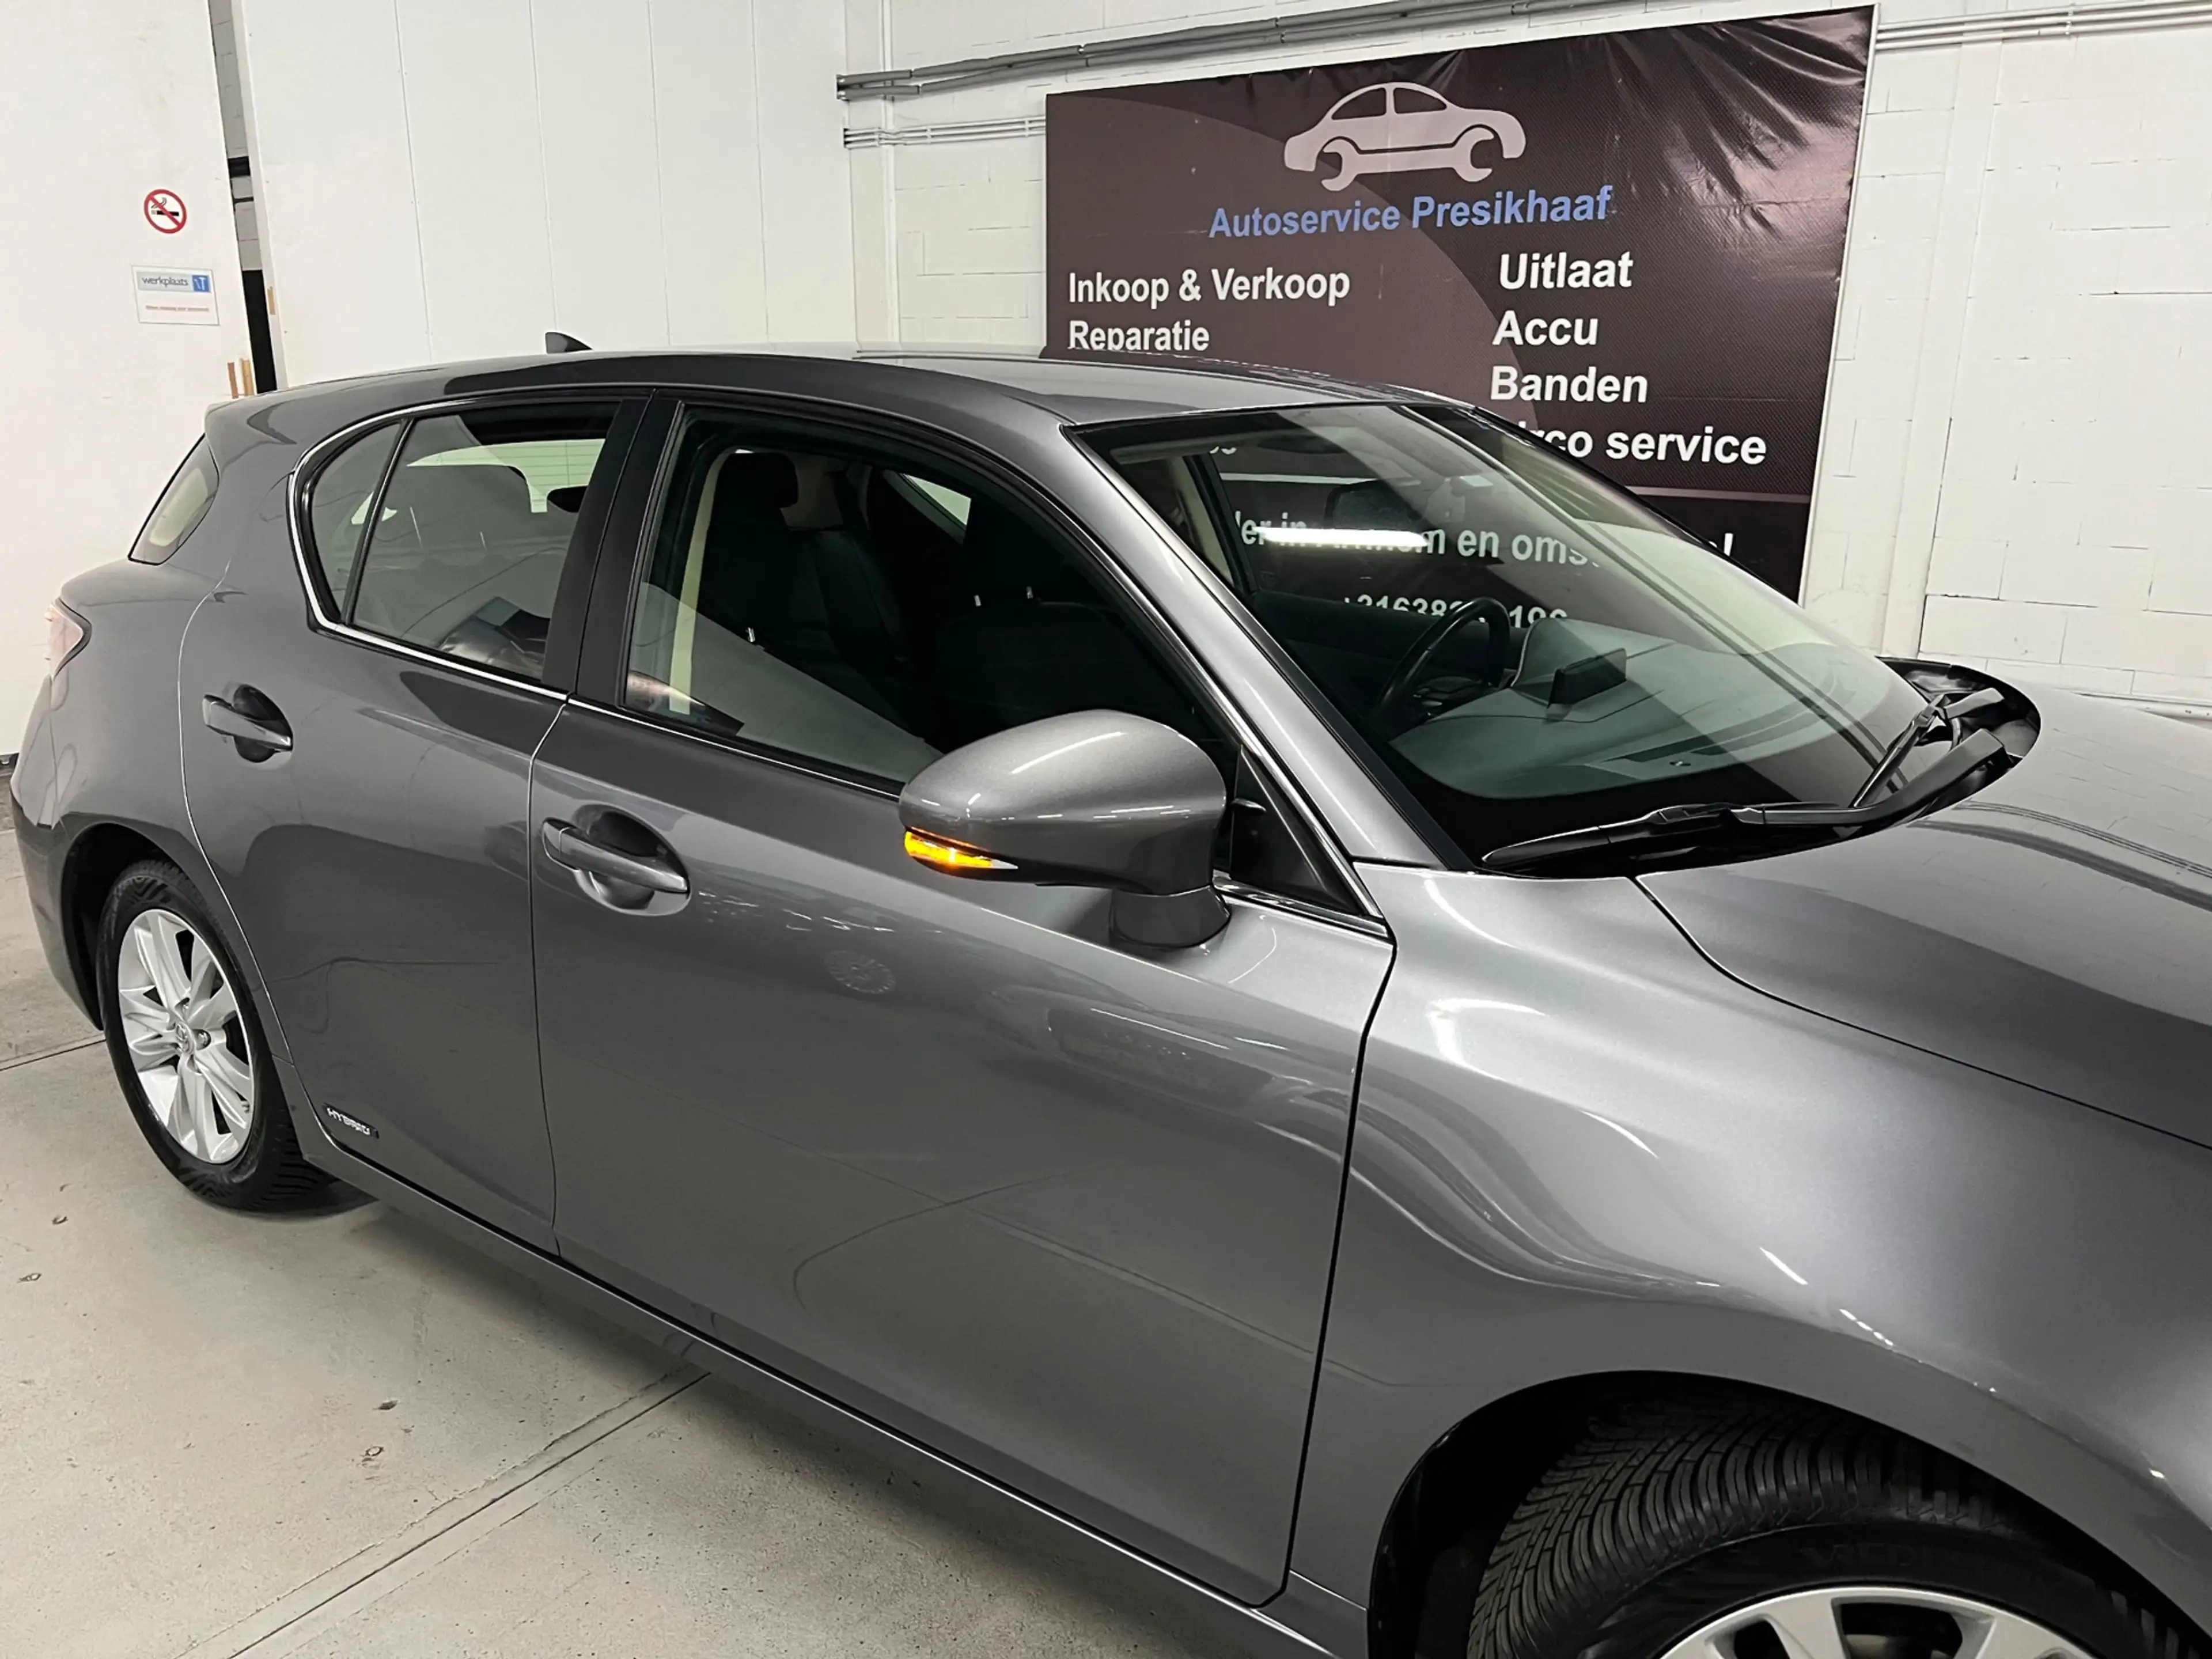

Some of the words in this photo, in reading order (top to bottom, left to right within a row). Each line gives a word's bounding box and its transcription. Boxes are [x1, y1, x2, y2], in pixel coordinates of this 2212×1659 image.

[1209, 201, 1400, 237] Autoservice
[1412, 185, 1612, 228] Presikhaaf
[142, 276, 189, 287] werkplaats
[1069, 272, 1169, 309] Inkoop
[1179, 268, 1202, 301] &
[1211, 267, 1350, 306] Verkoop
[1499, 251, 1634, 290] Uitlaat
[1069, 320, 1210, 350] Reparatie
[1492, 310, 1599, 346] Accu
[1491, 366, 1647, 403] Banden
[1606, 426, 1766, 464] service
[1457, 529, 1499, 558] en
